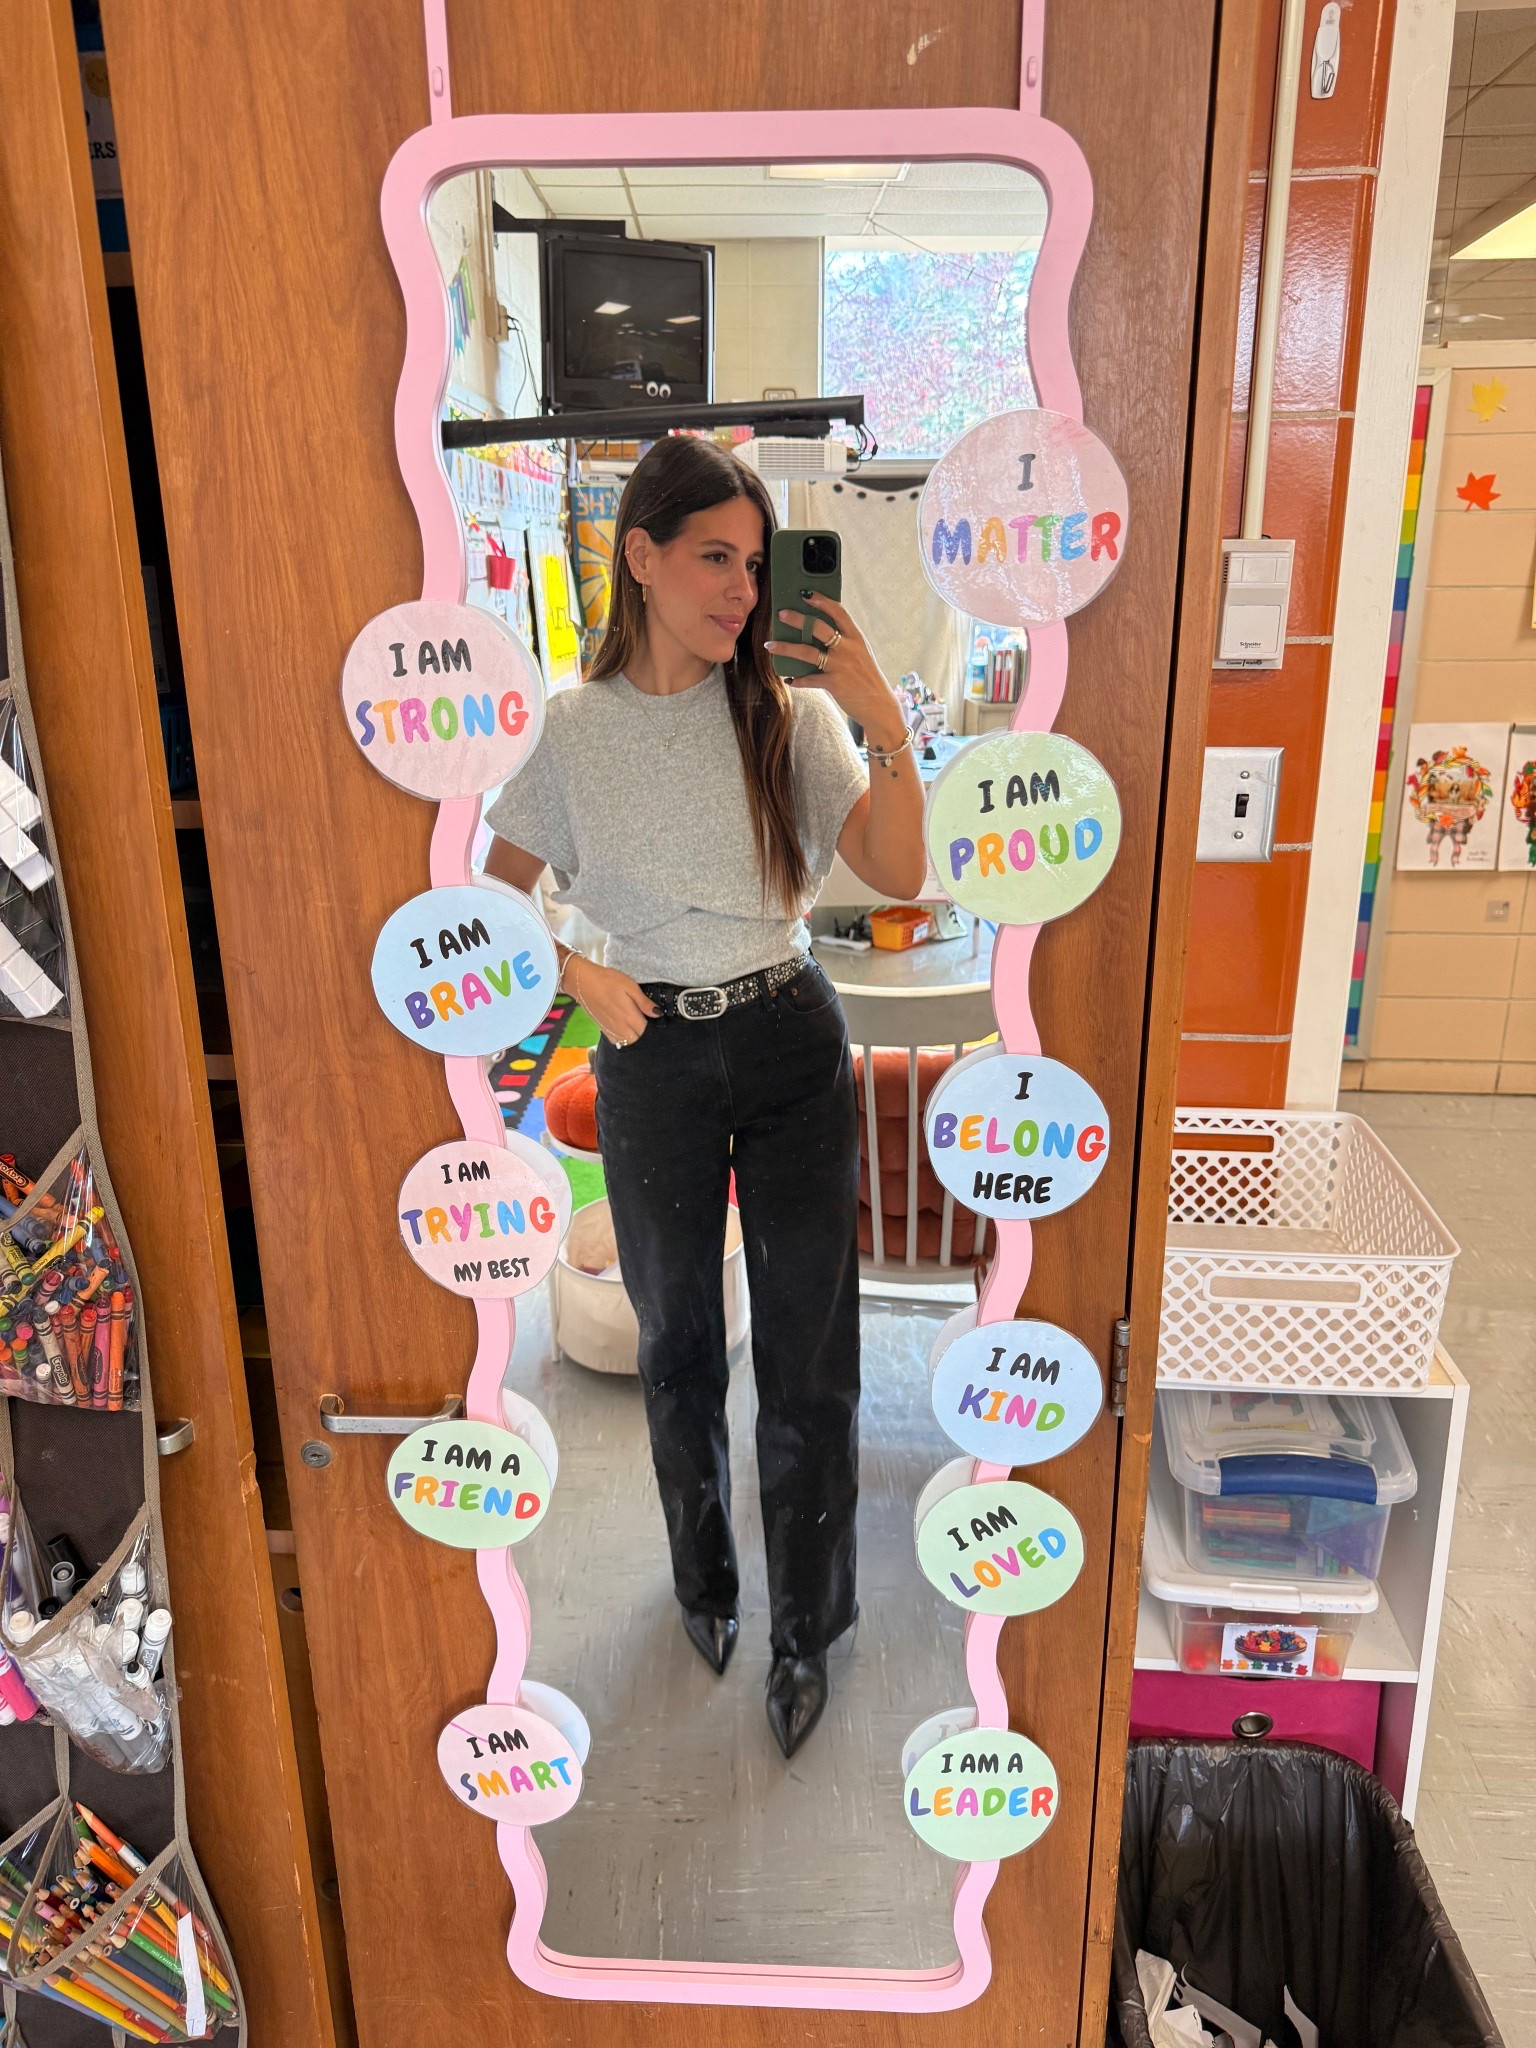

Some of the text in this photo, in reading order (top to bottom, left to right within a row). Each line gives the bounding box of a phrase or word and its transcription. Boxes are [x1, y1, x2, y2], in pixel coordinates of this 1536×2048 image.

[1017, 453, 1036, 491] I
[932, 511, 1121, 566] MATTER
[389, 638, 472, 677] I AM
[356, 691, 529, 746] STRONG
[977, 769, 1060, 814] I AM
[949, 817, 1103, 881] PROUD
[410, 917, 491, 969] I AM
[405, 950, 541, 1029] BRAVE
[1014, 1071, 1034, 1100] I
[933, 1112, 1106, 1163] BELONG
[0, 1160, 27, 1188] Crayo
[441, 1160, 490, 1184] I AM
[972, 1170, 1053, 1204] HERE
[401, 1196, 555, 1245] TRYING
[453, 1257, 530, 1282] MY BEST
[51, 1356, 69, 1385] Crayola
[985, 1347, 1060, 1386] I AM
[958, 1384, 1066, 1431] KIND
[421, 1439, 521, 1476] I AM A
[394, 1472, 541, 1520] FRIEND
[947, 1505, 1018, 1551] I AM
[950, 1528, 1066, 1598] LOVED
[144, 1649, 157, 1672] yola
[466, 1729, 529, 1758] I AM
[941, 1752, 1023, 1774] I AM A
[460, 1756, 572, 1801] SMART
[910, 1786, 1053, 1818] LEADER
